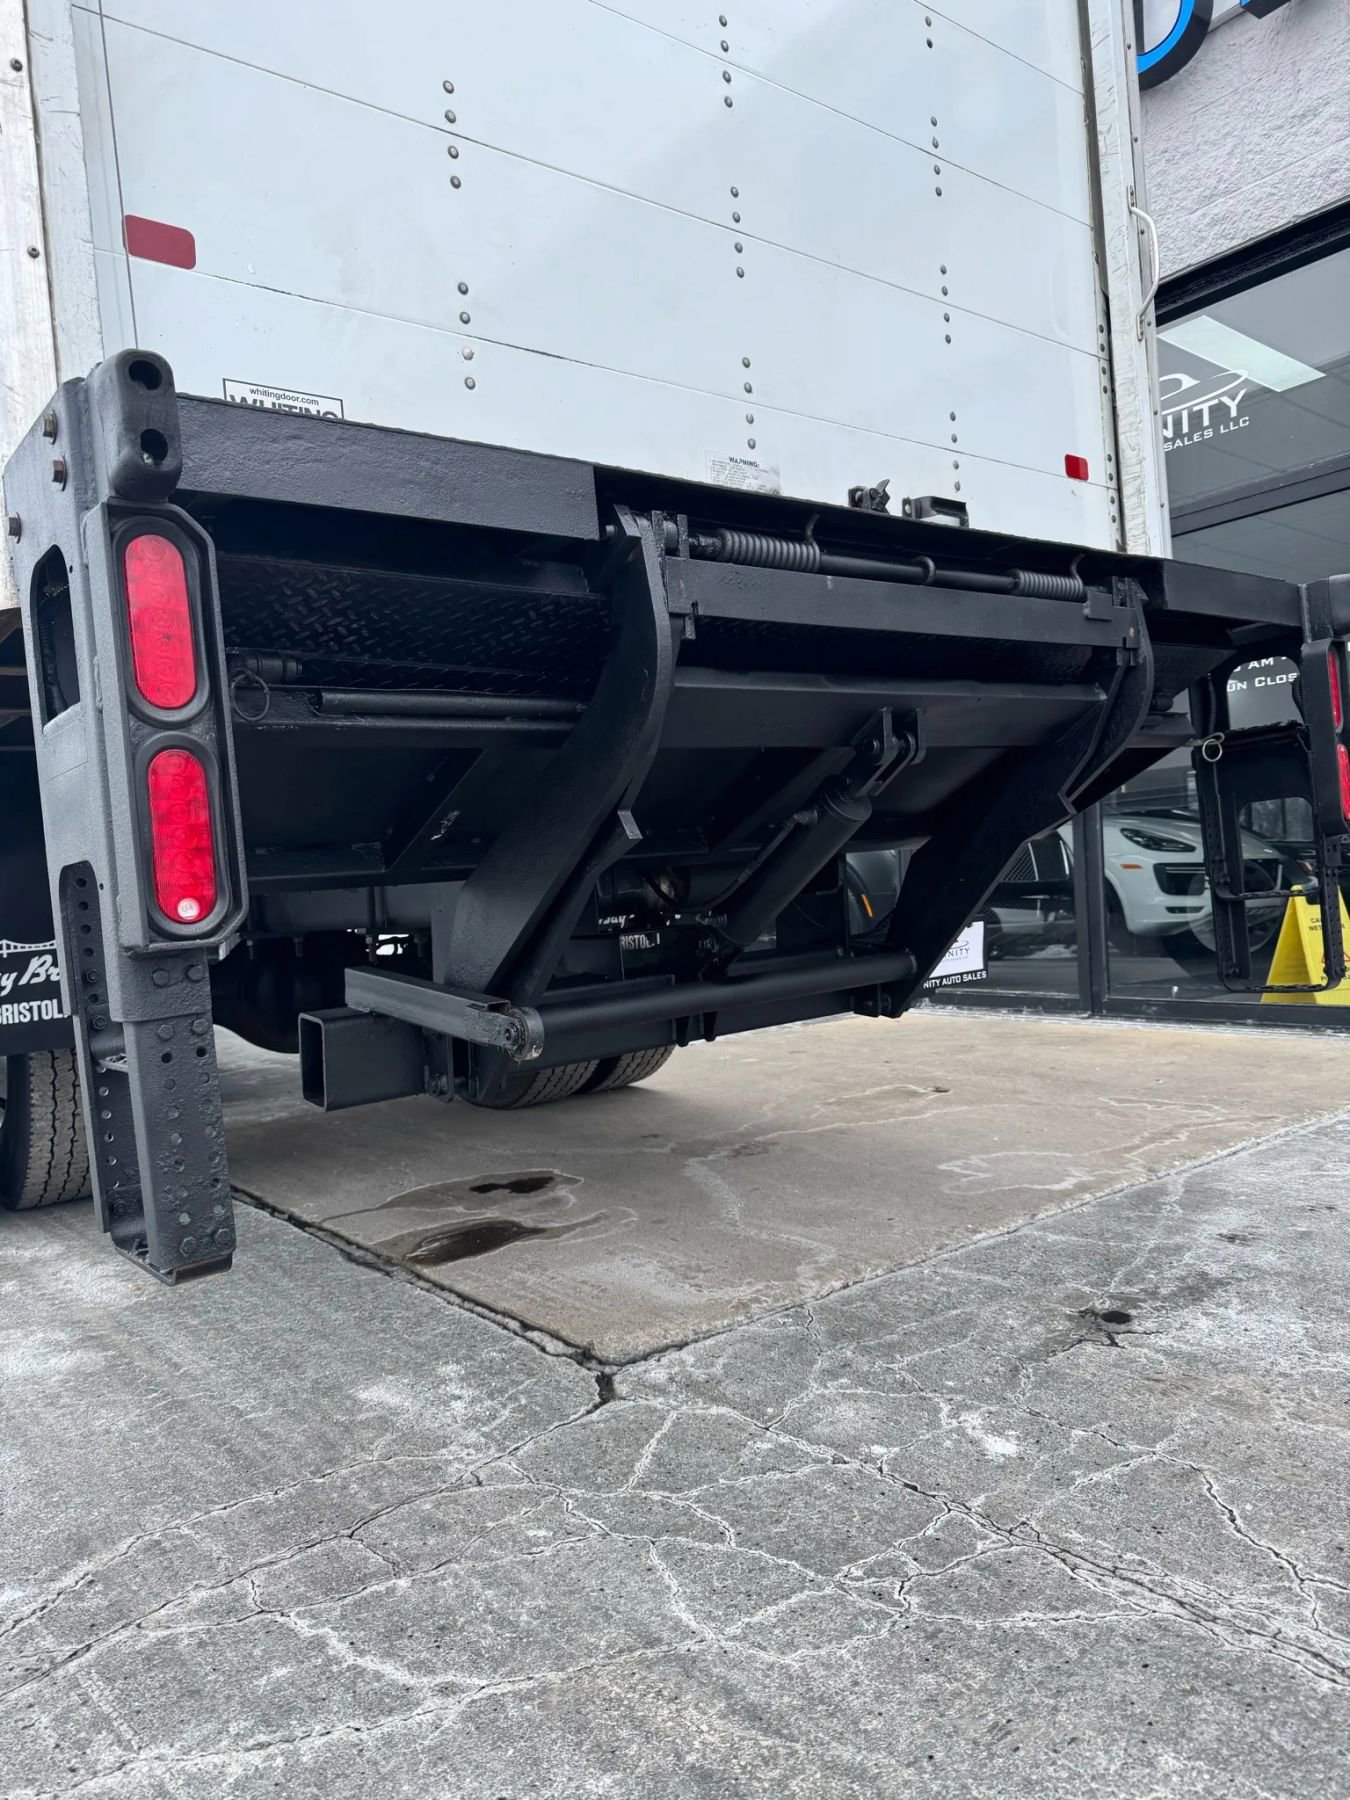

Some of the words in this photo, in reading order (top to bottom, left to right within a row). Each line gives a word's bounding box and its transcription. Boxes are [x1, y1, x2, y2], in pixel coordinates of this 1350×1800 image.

[249, 387, 319, 406] whitingdoor.com
[1164, 428, 1214, 452] SALES
[1220, 416, 1250, 434] LLC
[1248, 657, 1274, 670] AM
[942, 975, 962, 986] AUTO
[962, 970, 987, 982] SALES
